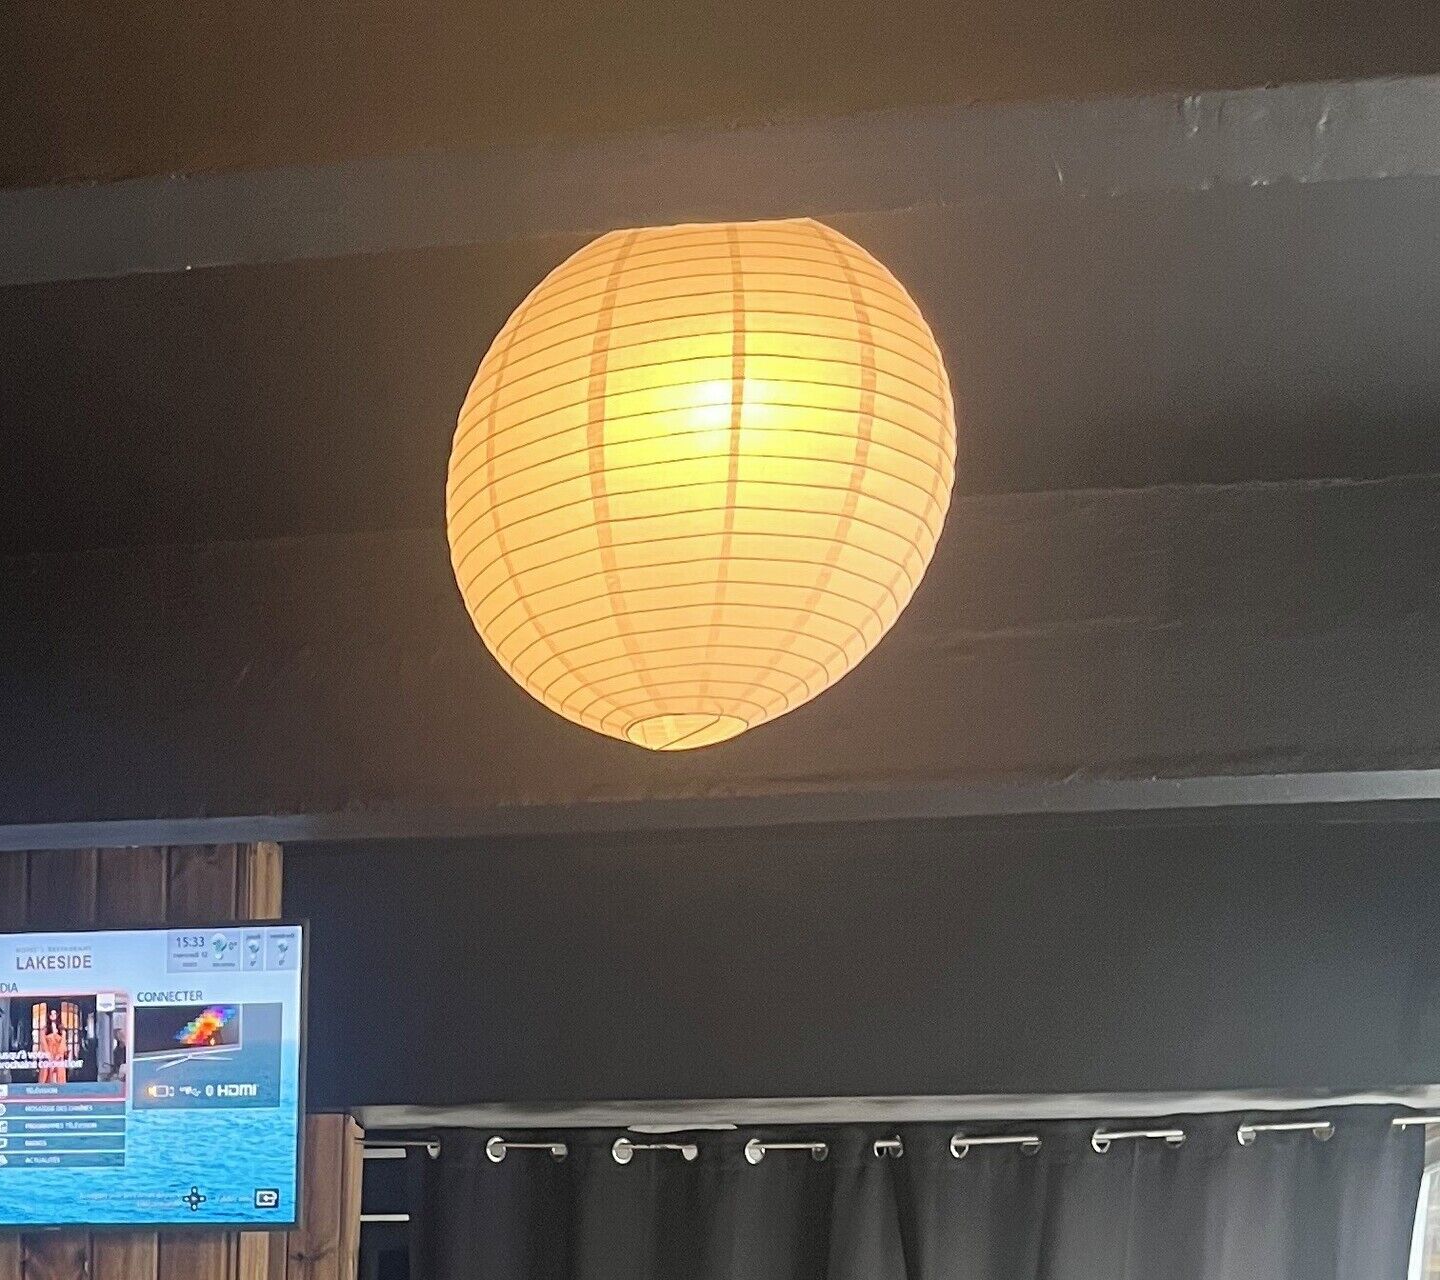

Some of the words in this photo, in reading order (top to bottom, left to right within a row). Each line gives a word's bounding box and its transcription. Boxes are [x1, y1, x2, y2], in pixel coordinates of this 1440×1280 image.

[16, 955, 92, 970] LAKESIDE
[136, 990, 204, 1003] CONNECTER
[217, 1084, 257, 1096] HDMI
